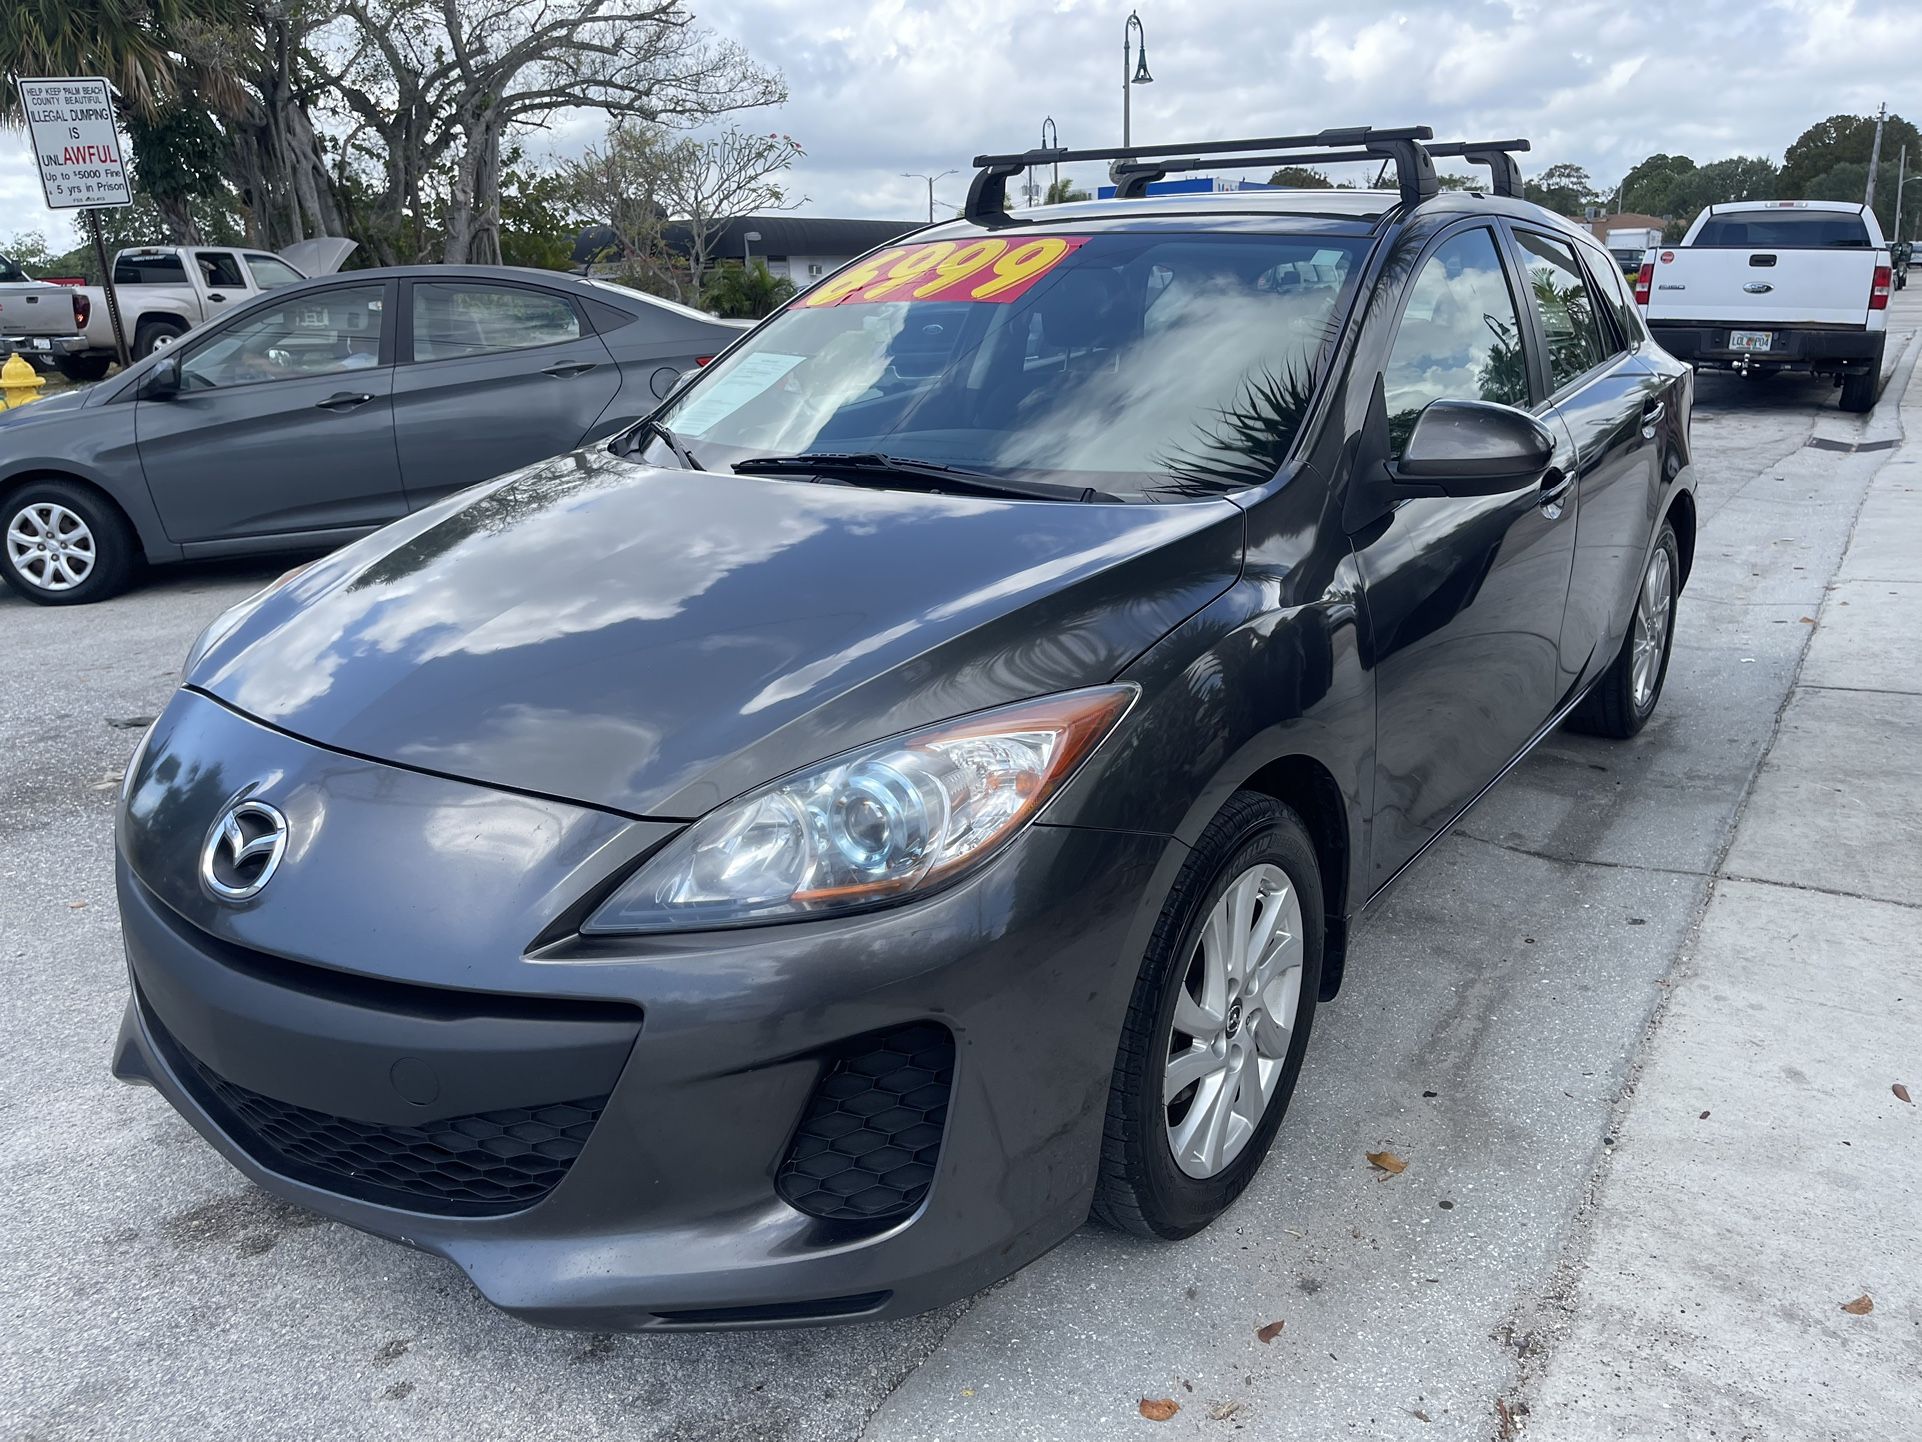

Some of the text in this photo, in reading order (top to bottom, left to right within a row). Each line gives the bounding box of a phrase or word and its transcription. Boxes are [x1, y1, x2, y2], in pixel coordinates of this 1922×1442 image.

[26, 86, 103, 97] HELP KEEP PALM BEACH
[32, 96, 103, 106] COUNTY BEAUTIFUL
[31, 108, 109, 123] ILLEGAL DUMPING
[68, 127, 80, 140] IS
[42, 145, 118, 167] UNLAWFUL
[45, 169, 121, 184] Up to $5000 Fine
[56, 186, 64, 195] 5
[68, 185, 82, 197] yrs
[86, 183, 94, 193] in
[97, 182, 125, 193] Prison
[806, 238, 1070, 306] 6999
